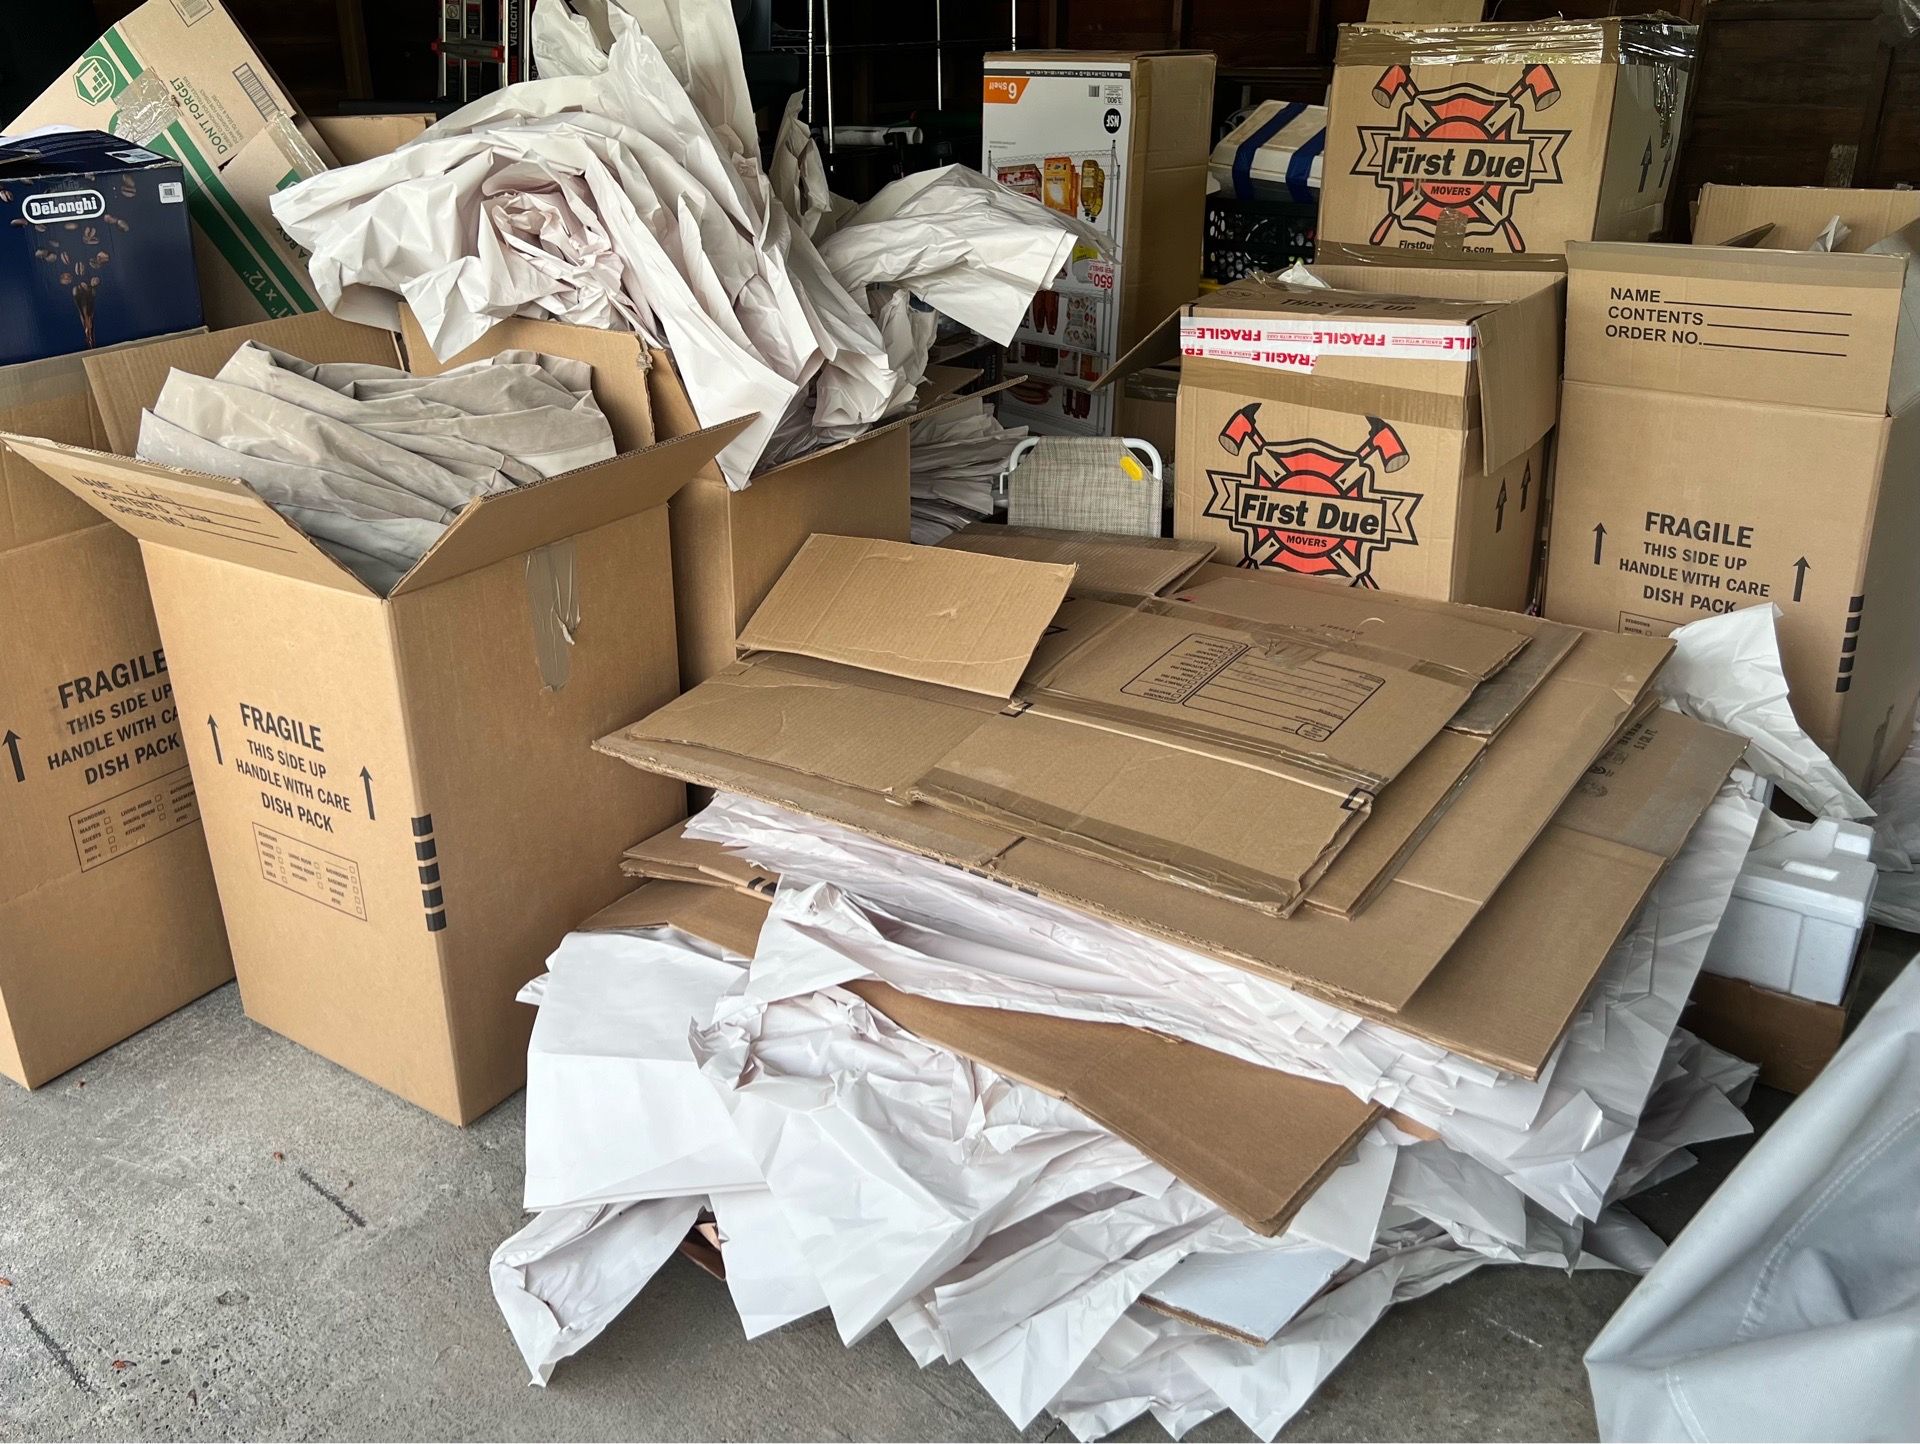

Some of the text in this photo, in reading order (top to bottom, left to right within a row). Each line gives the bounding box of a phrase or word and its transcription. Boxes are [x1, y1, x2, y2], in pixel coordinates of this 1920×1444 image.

[989, 82, 1017, 99] 6 Shelf
[170, 77, 228, 154] DON'T FORGET
[1106, 114, 1120, 127] NSF
[1386, 146, 1525, 178] First Due
[1430, 186, 1472, 196] MOVERS
[1094, 274, 1113, 288] 650
[1280, 299, 1328, 307] THIS
[1384, 304, 1416, 312] UP
[1610, 287, 1661, 303] NAME
[1608, 306, 1704, 326] CONTENTS
[1197, 328, 1261, 341] FRAGILE
[1313, 331, 1386, 346] FRAGILE
[1606, 324, 1702, 345] ORDER NO.
[92, 488, 170, 514] CONTENTS
[110, 502, 158, 521] ORDER
[1240, 494, 1380, 535] First Due
[1286, 535, 1328, 548] MOVERS
[1645, 512, 1754, 548] FRAGILE
[1644, 542, 1747, 570] THIS SIDE UP
[1619, 558, 1770, 597] HANDLE WITH CARE
[1644, 585, 1736, 614] DISH PACK
[58, 648, 168, 709] FRAGILE
[67, 683, 173, 735] THIS SIDE UP
[48, 705, 179, 770] HANDLE WITH CA
[240, 702, 325, 752] FRAGILE
[85, 732, 180, 785] DISH PACK
[247, 739, 326, 779] THIS SIDE UP
[236, 758, 352, 813] HANDLE WITH CARE
[261, 792, 334, 834] DISH PACK
[80, 822, 100, 834] MASTER
[82, 832, 102, 844] GUESTS
[125, 823, 146, 836] KITCHEN
